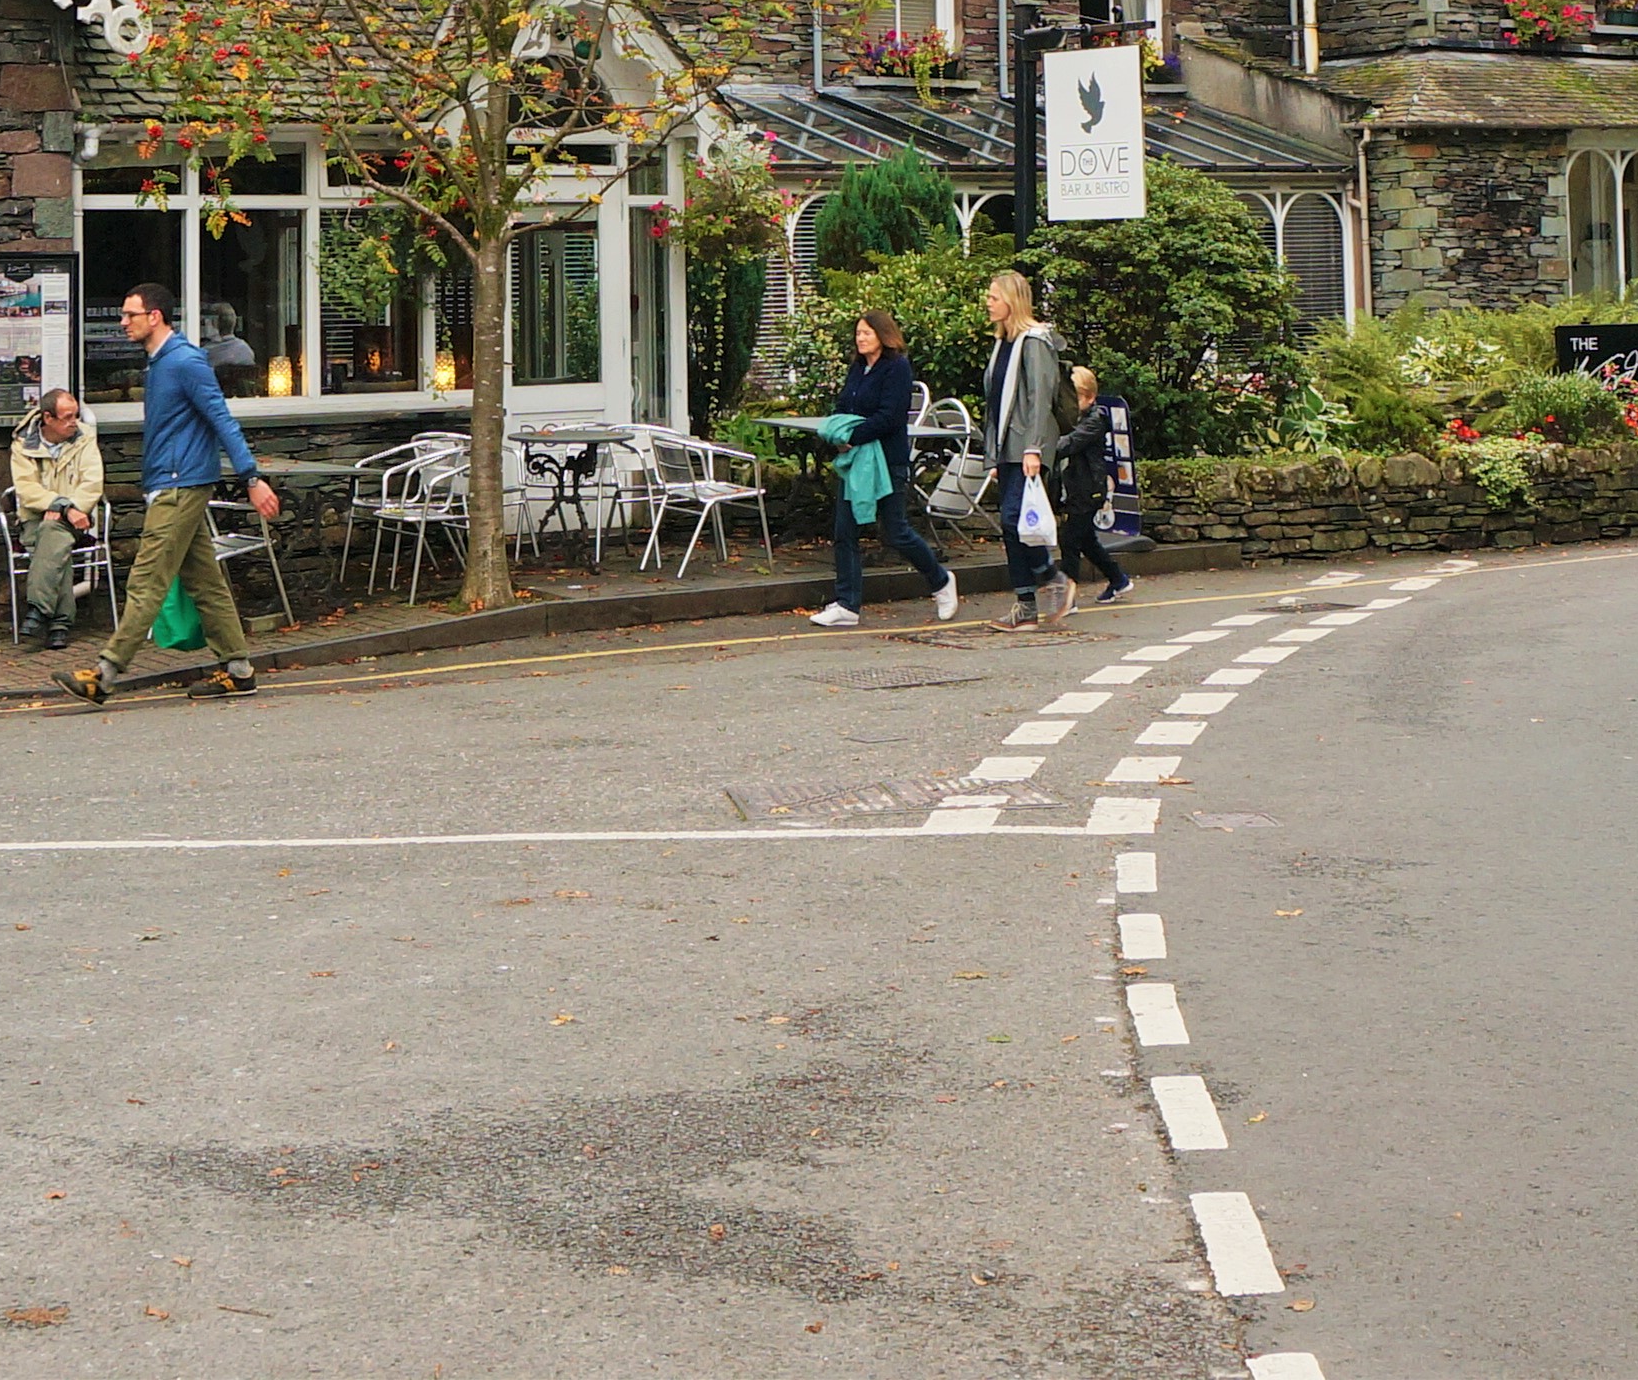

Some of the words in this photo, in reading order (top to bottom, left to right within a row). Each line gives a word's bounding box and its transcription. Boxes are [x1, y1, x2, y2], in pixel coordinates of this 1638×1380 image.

[1060, 146, 1129, 176] DOVE
[1061, 183, 1081, 196] BAR
[1084, 183, 1092, 196] &
[1095, 181, 1130, 196] BISTRO
[1570, 337, 1599, 352] THE
